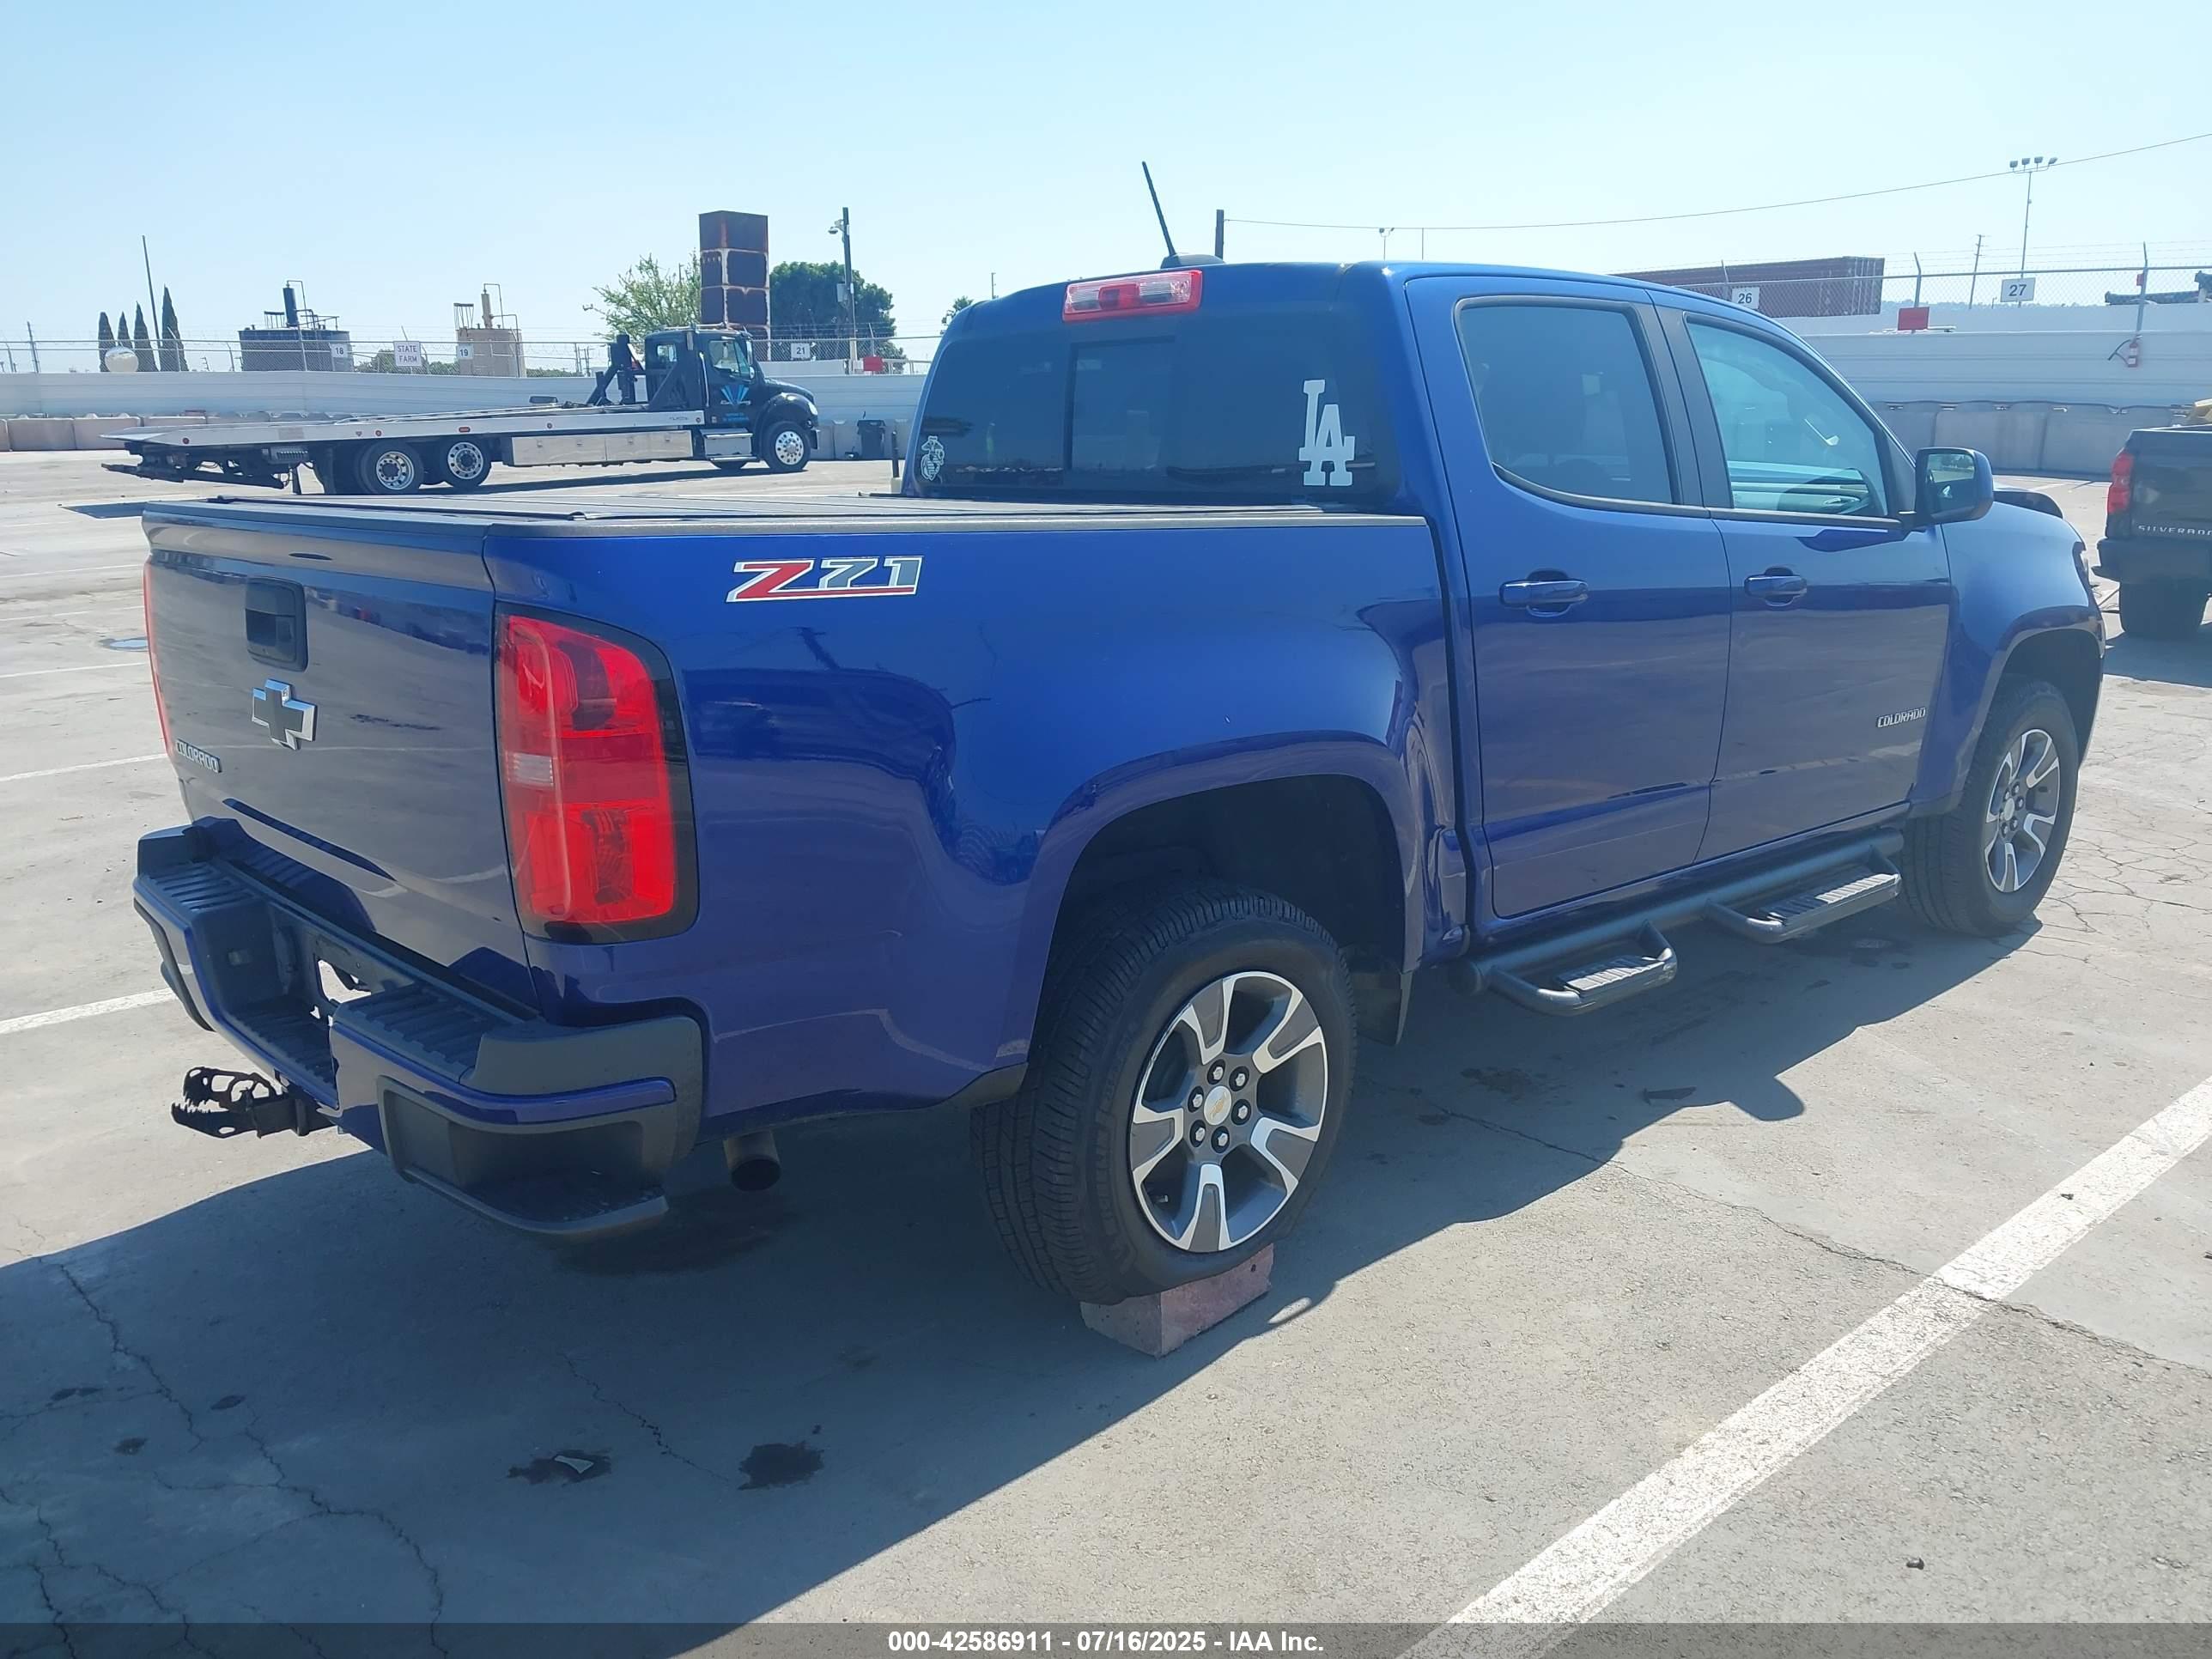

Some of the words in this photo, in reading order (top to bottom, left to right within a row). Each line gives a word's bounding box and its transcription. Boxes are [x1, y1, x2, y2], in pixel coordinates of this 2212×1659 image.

[1738, 292, 1753, 305] 26
[2008, 283, 2027, 297] 27
[336, 346, 343, 355] 18
[1298, 379, 1356, 487] LA
[726, 558, 923, 603] Z71
[1877, 707, 1926, 728] COLORADO
